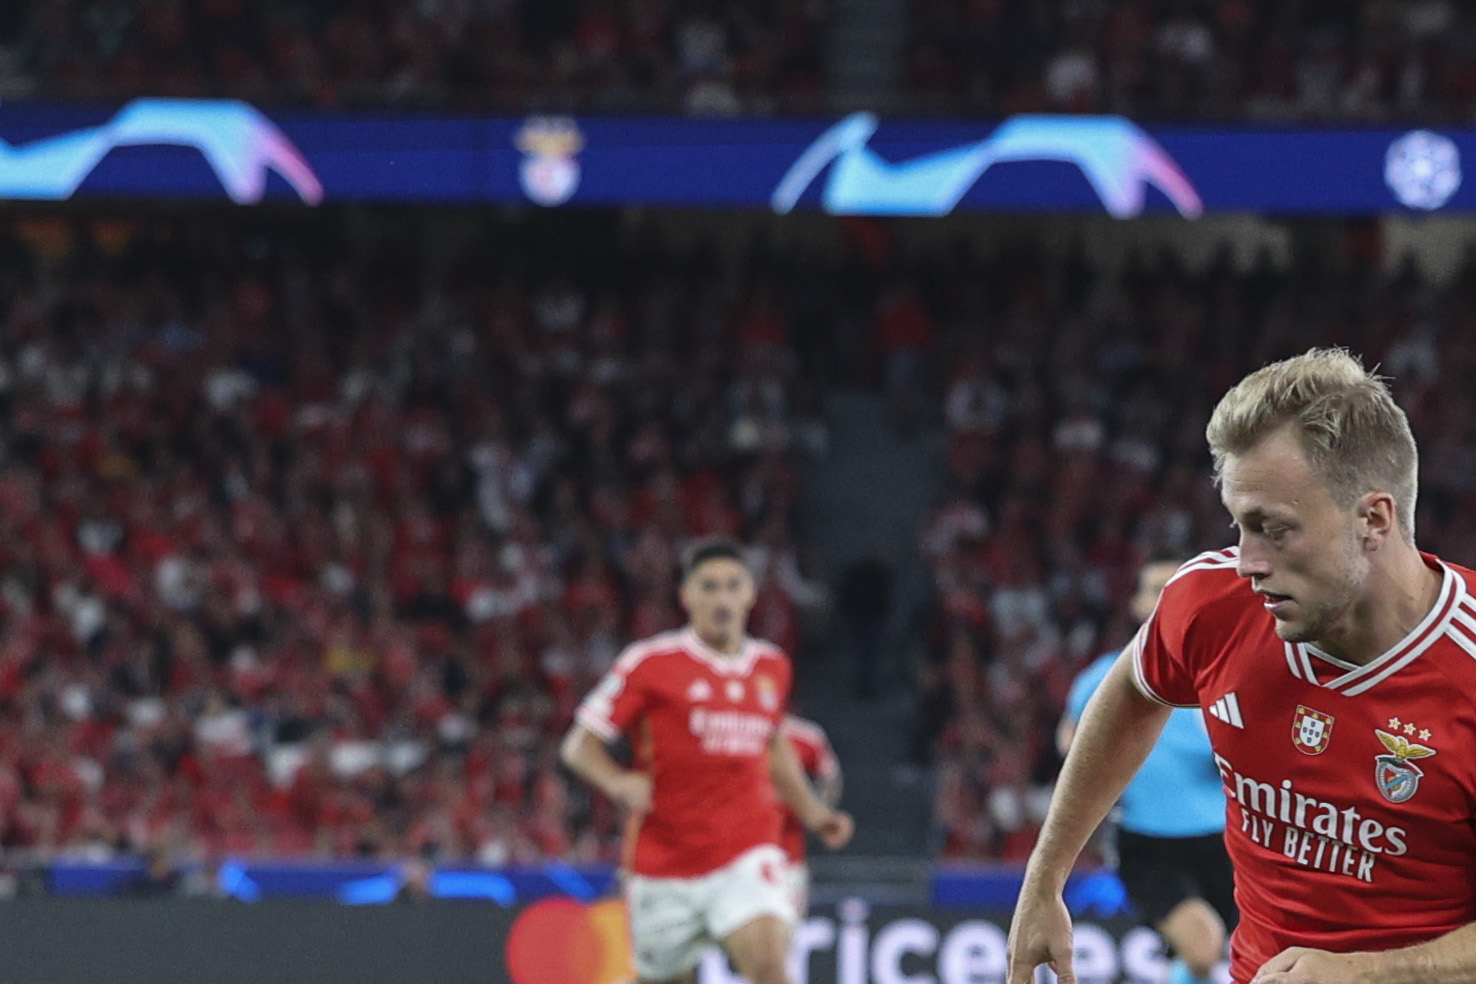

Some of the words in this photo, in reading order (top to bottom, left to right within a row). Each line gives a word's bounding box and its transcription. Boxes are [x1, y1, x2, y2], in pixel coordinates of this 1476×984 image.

[1214, 752, 1409, 857] Emirates
[1241, 808, 1275, 849] FLY
[1283, 826, 1376, 883] BETTER
